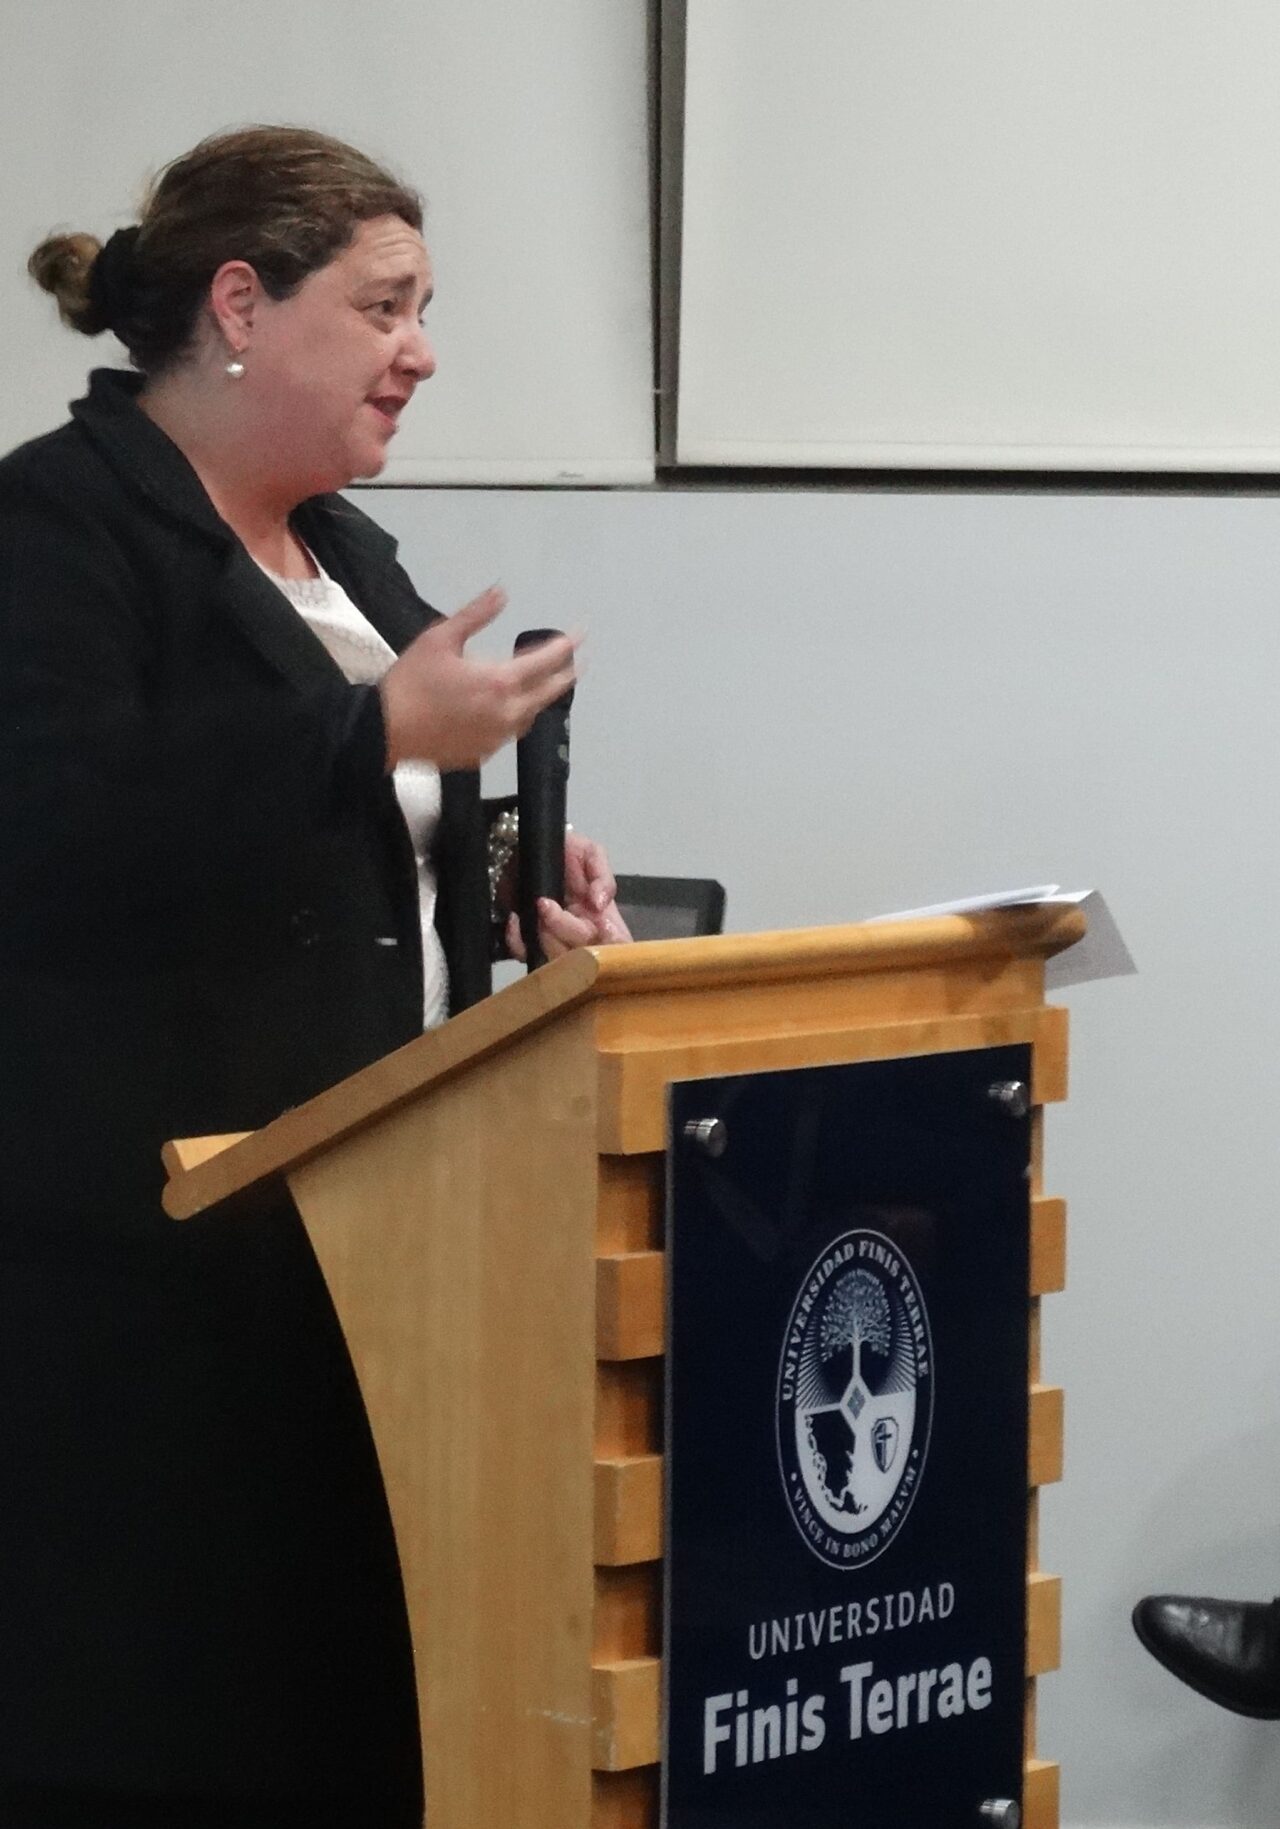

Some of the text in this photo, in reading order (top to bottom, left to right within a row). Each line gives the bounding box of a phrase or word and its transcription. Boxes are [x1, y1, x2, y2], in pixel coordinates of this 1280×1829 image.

[782, 1240, 929, 1400] UNIVERSIDAD FINIS TERRAE
[794, 1488, 824, 1543] VINCE
[825, 1536, 840, 1555] IN
[749, 1582, 955, 1660] UNIVERSIDAD
[703, 1656, 992, 1775] Finis Terrae
